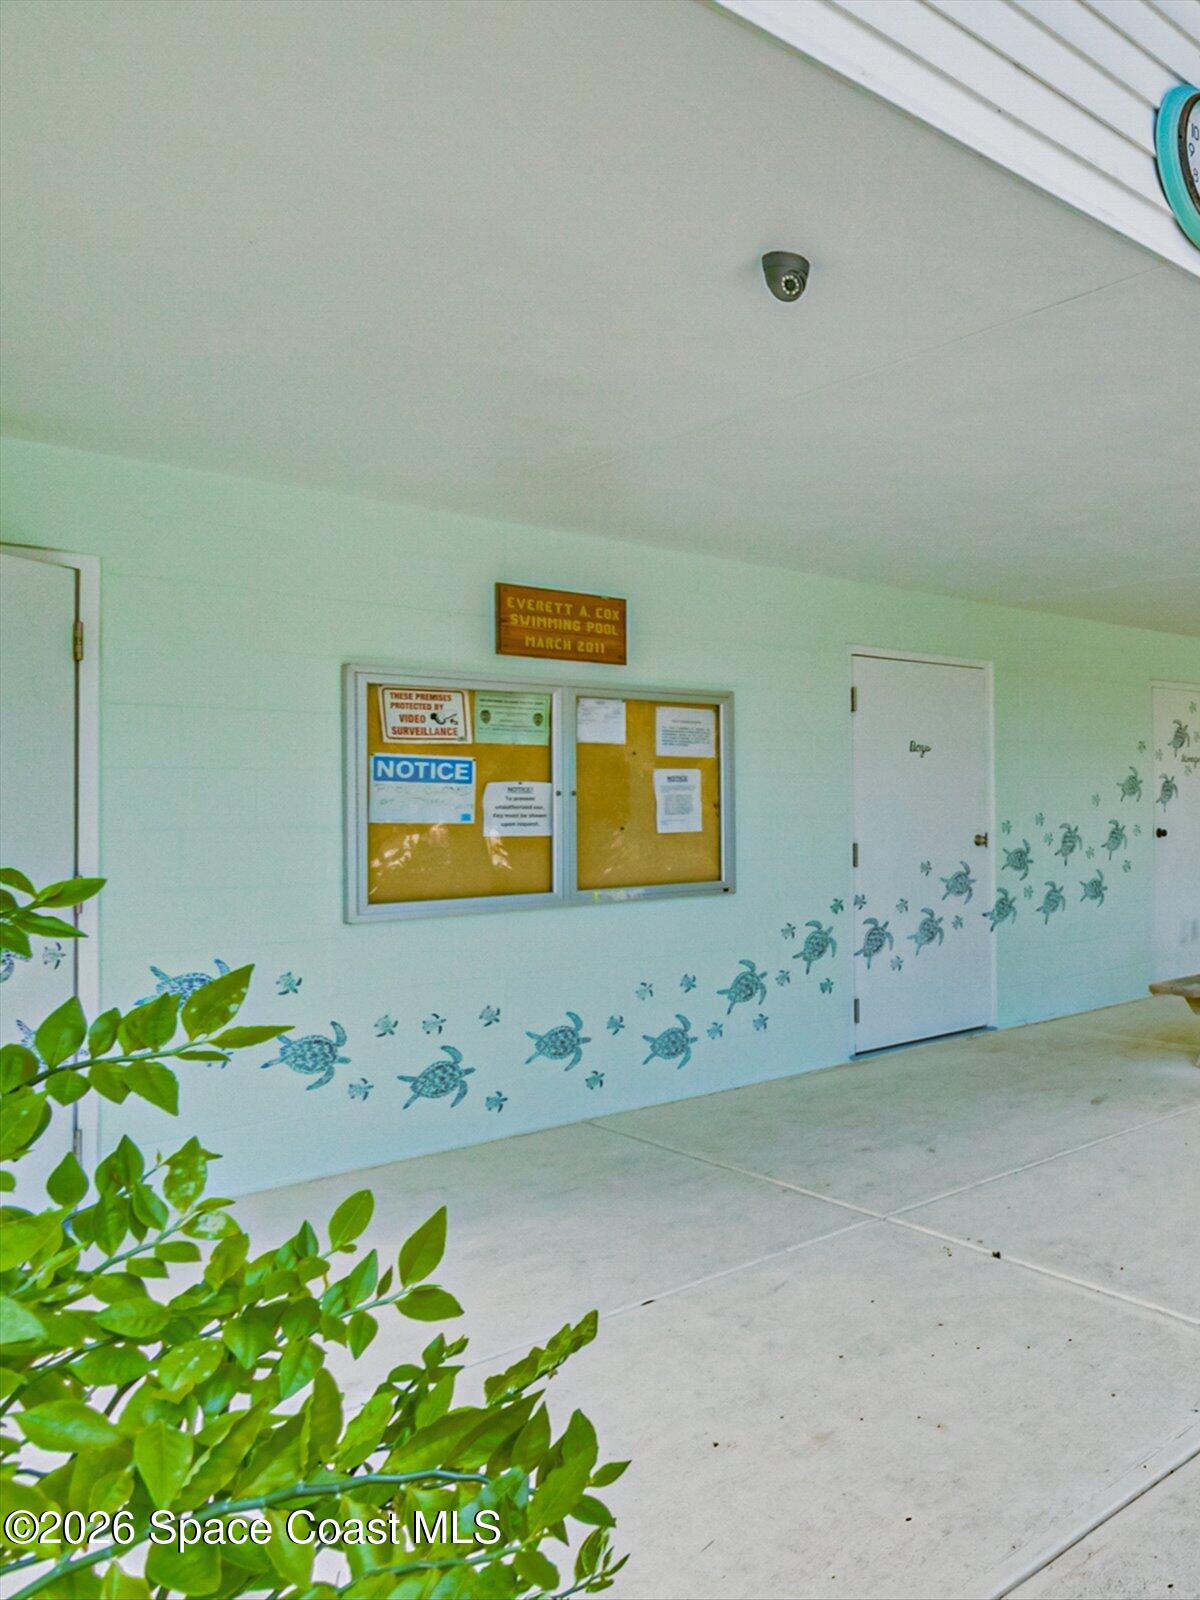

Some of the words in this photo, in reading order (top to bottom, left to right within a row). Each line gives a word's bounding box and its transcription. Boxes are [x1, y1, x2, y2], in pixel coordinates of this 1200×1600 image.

[1191, 123, 1200, 141] 10
[1189, 142, 1195, 157] 9
[1193, 167, 1199, 183] 8
[507, 596, 573, 615] EVERETT
[579, 605, 592, 618] A.
[595, 607, 620, 621] COX
[510, 613, 581, 632] SWIMMING
[586, 621, 619, 636] POOL
[525, 635, 572, 651] MARCH
[577, 641, 605, 655] 2011
[390, 692, 413, 700] THESE
[415, 693, 452, 702] PREMISES
[390, 702, 432, 711] PROTECTED
[434, 703, 444, 711] BY
[399, 713, 426, 724] VIDEO
[391, 726, 458, 736] SURVEILLANCE
[376, 760, 470, 780] NOTICE
[666, 775, 688, 783] NOTICE
